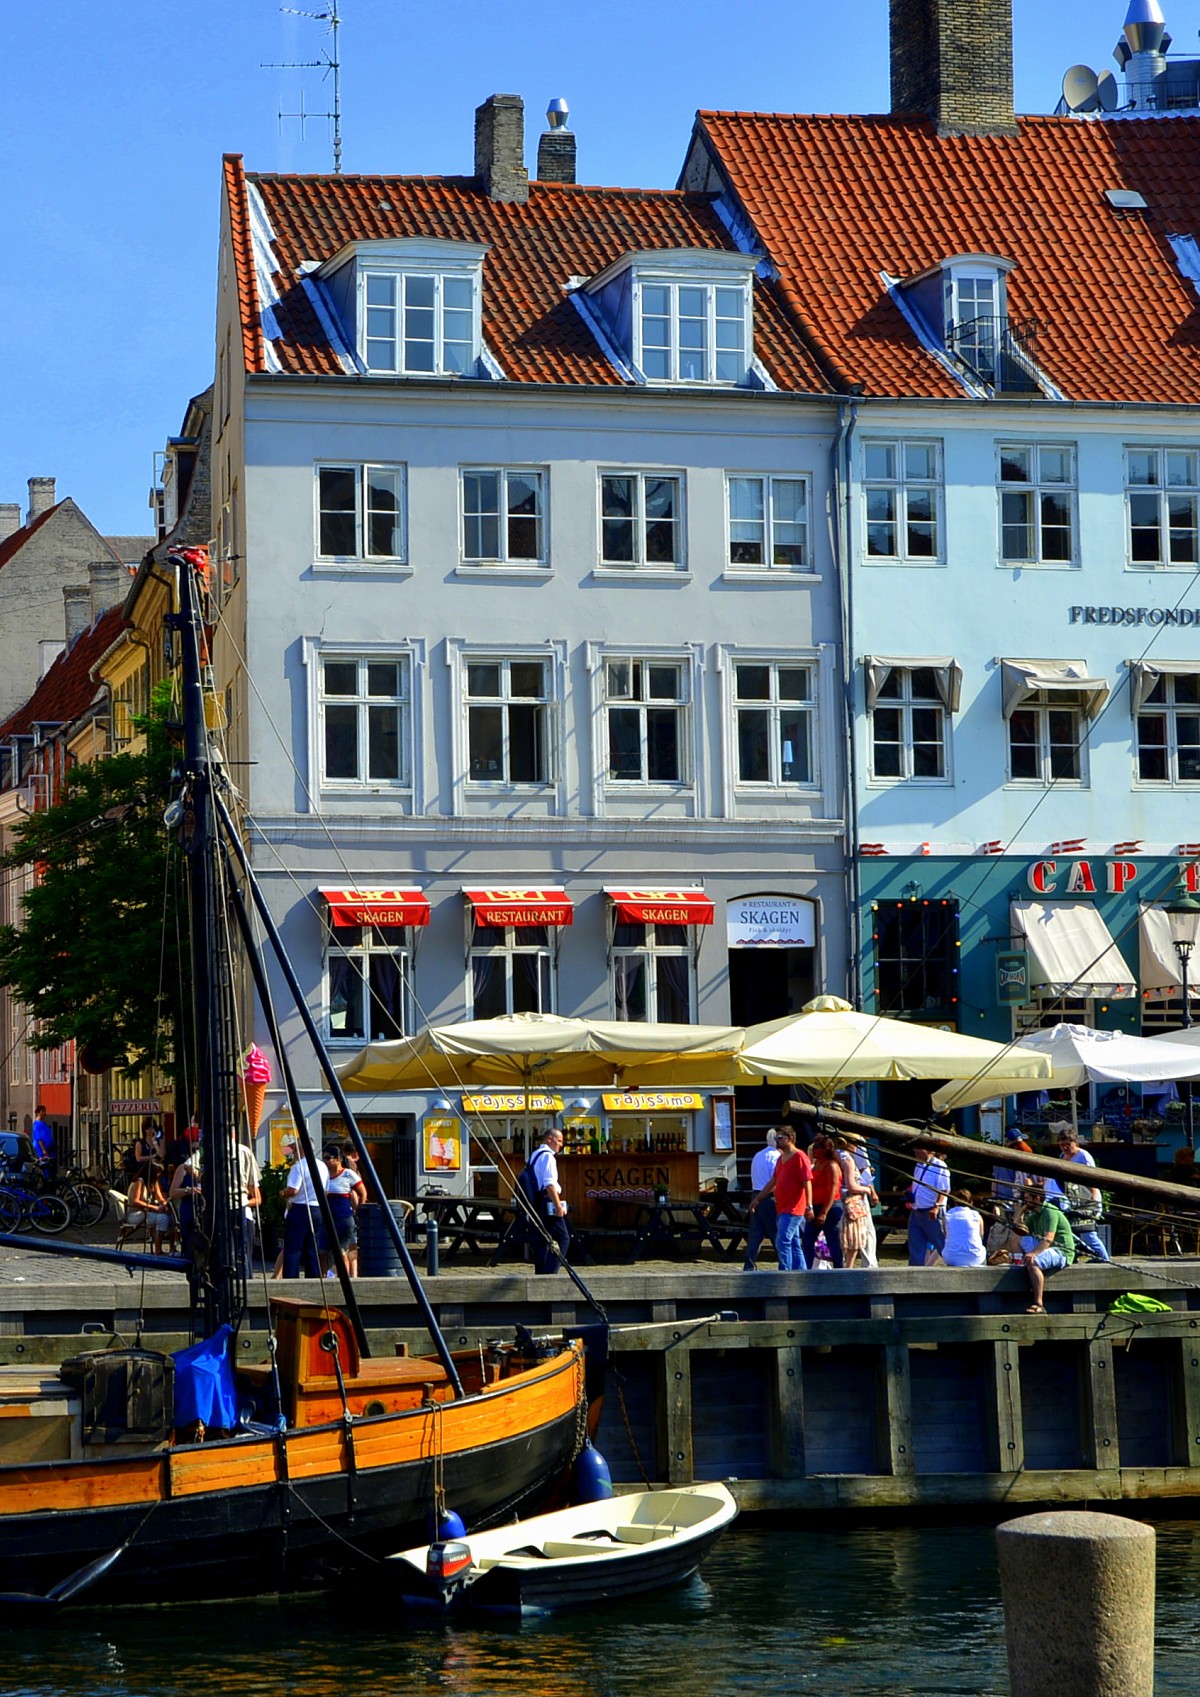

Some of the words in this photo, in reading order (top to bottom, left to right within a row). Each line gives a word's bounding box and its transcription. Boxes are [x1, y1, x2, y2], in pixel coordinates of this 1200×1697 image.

[1027, 860, 1138, 894] CAP
[356, 911, 404, 922] SKAGEN
[486, 910, 564, 922] RESTAURANT
[641, 909, 688, 920] SKAGEN
[740, 911, 799, 924] SKAGEN
[111, 1102, 159, 1112] PIZZERIA
[613, 1094, 693, 1108] rajissimo
[584, 1167, 670, 1187] SKAGEN
